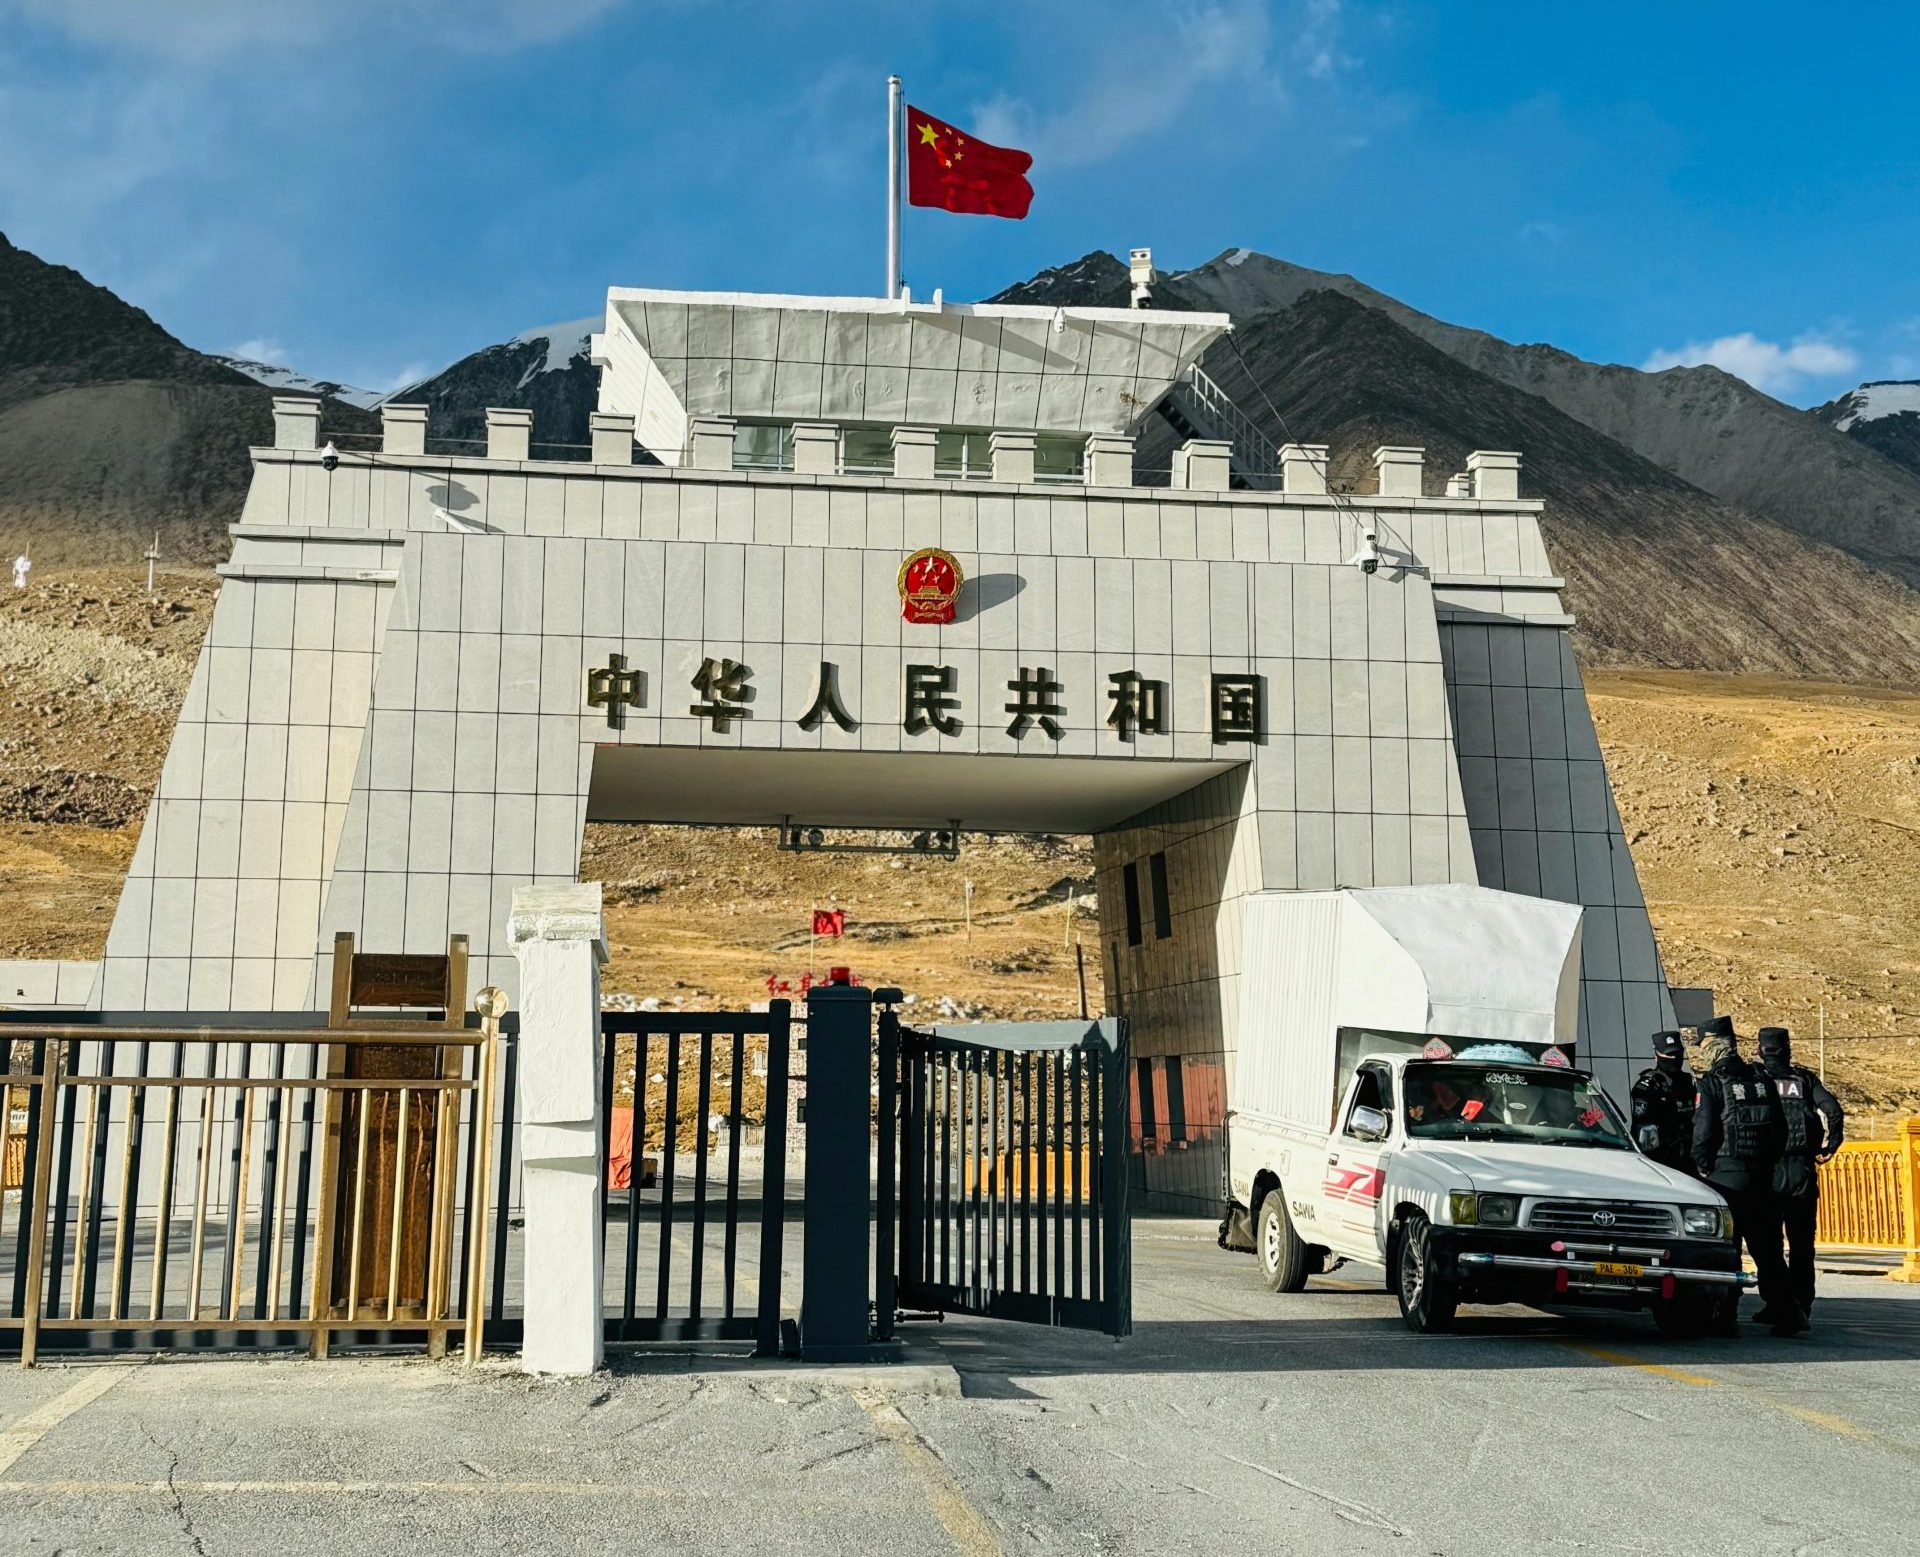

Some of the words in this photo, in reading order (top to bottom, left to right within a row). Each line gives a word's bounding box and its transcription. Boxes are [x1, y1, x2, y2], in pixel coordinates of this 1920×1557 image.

[588, 653, 1261, 744] 中华人民共和国
[1292, 1201, 1316, 1222] SAWA
